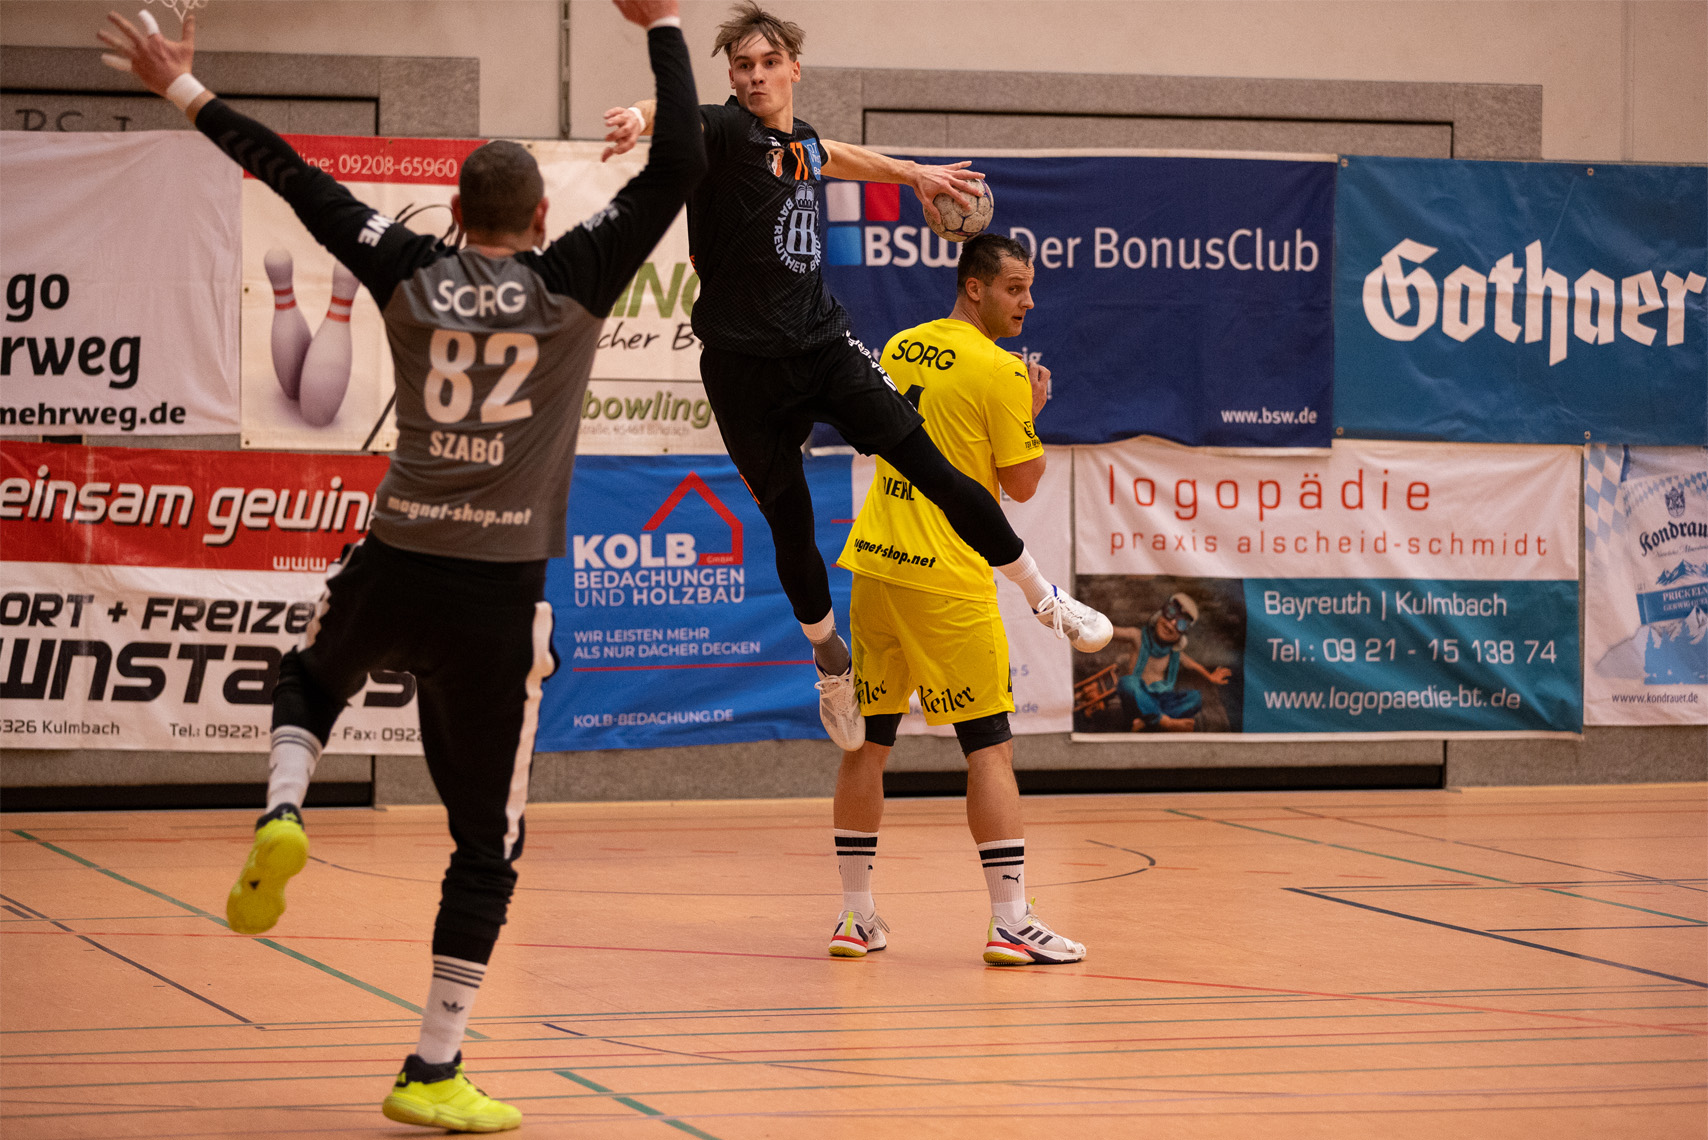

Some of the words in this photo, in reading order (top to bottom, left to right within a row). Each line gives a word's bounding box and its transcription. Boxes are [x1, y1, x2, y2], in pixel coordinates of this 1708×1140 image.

[339, 154, 458, 178] 09208-65960
[774, 197, 807, 274] BAYREUTHER
[1007, 227, 1082, 269] Der
[1094, 227, 1319, 272] BonusClub
[5, 273, 70, 323] go
[432, 279, 527, 317] SORG
[1362, 238, 1707, 367] Gothaer
[891, 339, 956, 371] SORG
[423, 329, 539, 424] 82
[1221, 407, 1318, 424] www.bsw.de
[429, 431, 505, 466] SZABÓ
[1109, 464, 1431, 521] logopädie
[202, 476, 377, 546] gewin
[387, 496, 532, 528] magnet-shop.net
[573, 533, 698, 570] KOLB
[1110, 529, 1218, 556] praxis
[1237, 530, 1548, 557] alscheid-schmidt
[574, 568, 745, 590] BEDACHUNGEN
[575, 588, 626, 608] UND
[633, 586, 745, 606] HOLZBAU
[1264, 591, 1371, 621] Bayreuth
[1396, 591, 1508, 617] Kulmbach
[573, 646, 600, 660] ALS
[603, 644, 635, 659] NUR
[638, 641, 699, 658] DÄCHER
[702, 641, 761, 656] DECKEN
[574, 630, 603, 644] WIR
[606, 628, 663, 643] LEISTEN
[667, 627, 710, 641] MEHR
[1267, 638, 1315, 662] Tel.:
[1323, 638, 1356, 663] 09
[1365, 638, 1397, 662] 21
[1428, 638, 1460, 664] 15
[1472, 639, 1515, 665] 138
[1524, 640, 1558, 664] 74
[919, 685, 975, 714] Keiler
[1264, 684, 1521, 716] www.logopaedie-bt.de
[42, 720, 120, 736] Kulmbach
[343, 726, 377, 741] Fax:
[573, 708, 734, 728] KOLB-BEDACHUNG.DE
